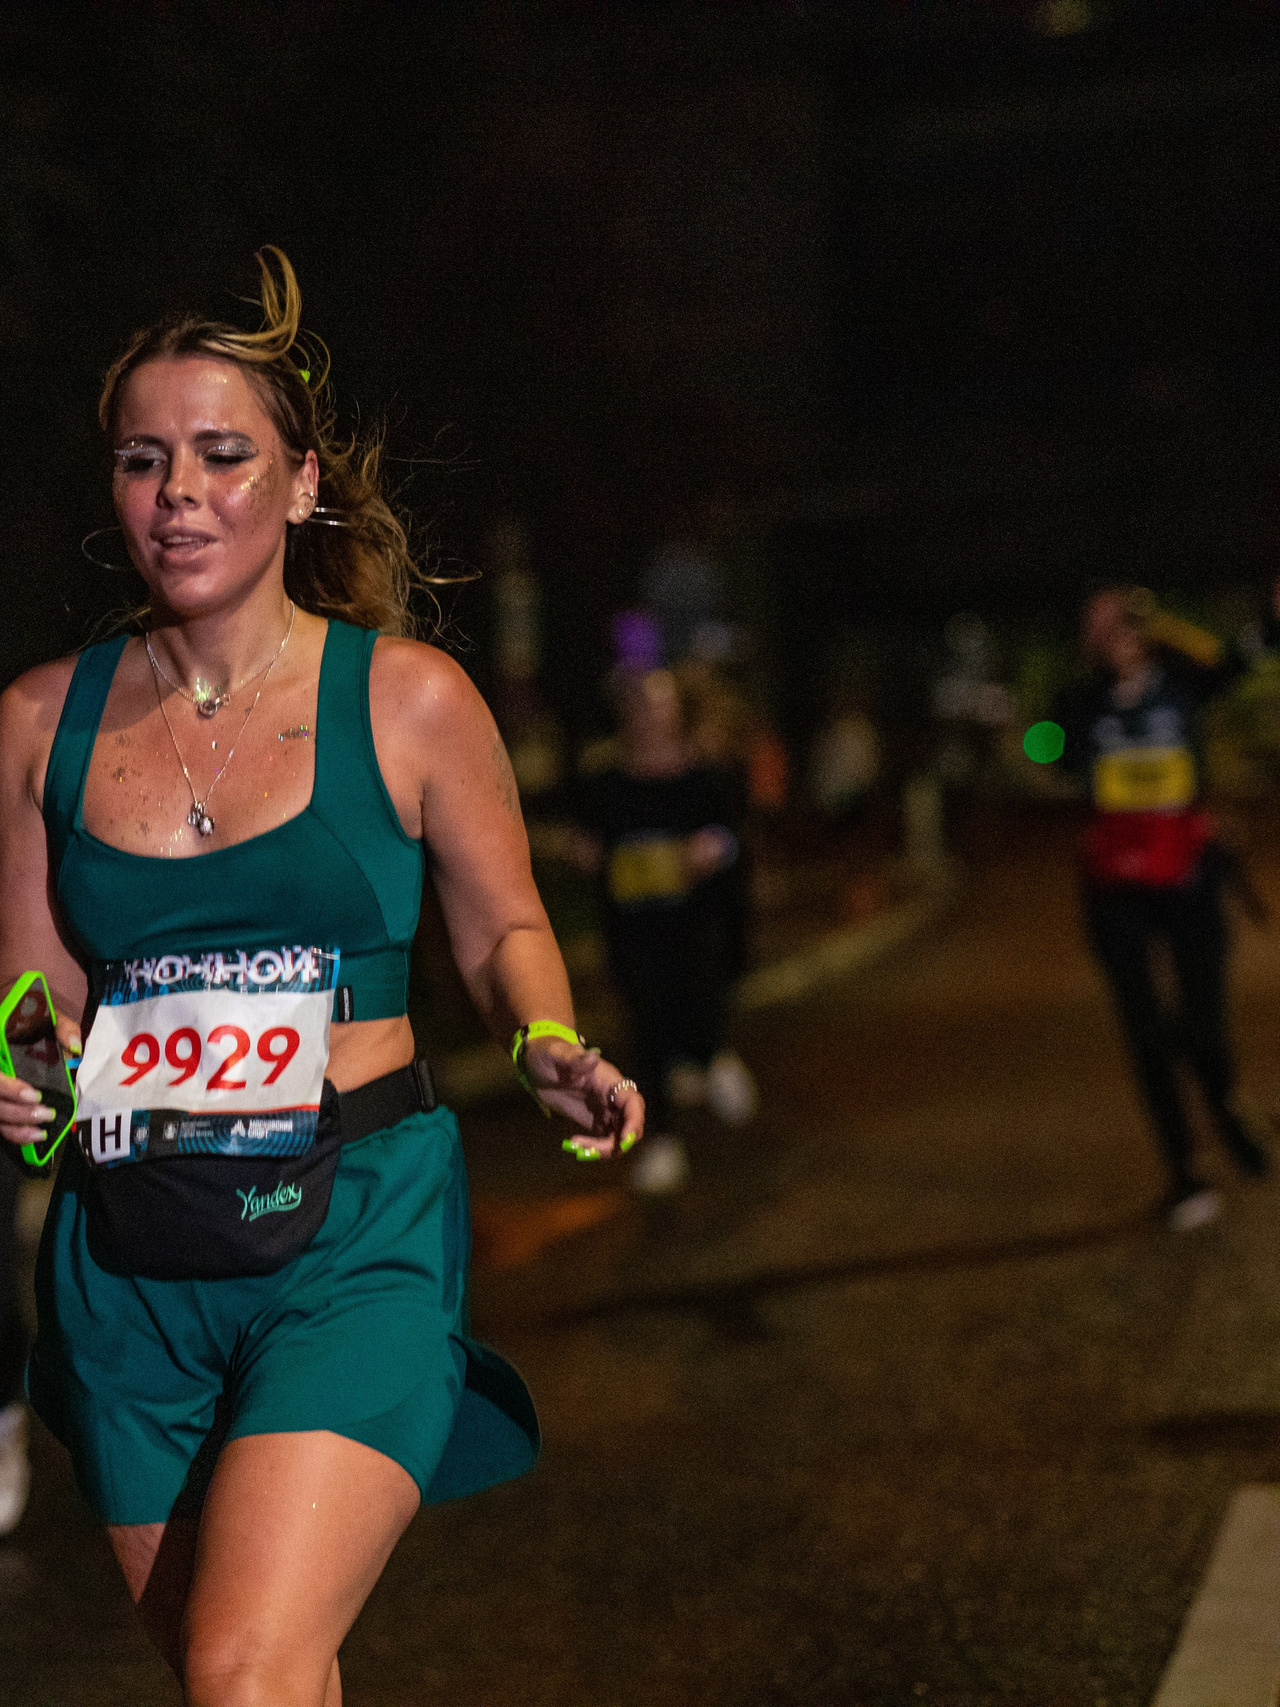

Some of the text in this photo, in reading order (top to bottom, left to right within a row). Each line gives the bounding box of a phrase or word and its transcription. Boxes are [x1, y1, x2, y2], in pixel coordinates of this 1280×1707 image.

[118, 1023, 301, 1091] 9929
[99, 1115, 122, 1154] H
[235, 1180, 302, 1222] Yandex
